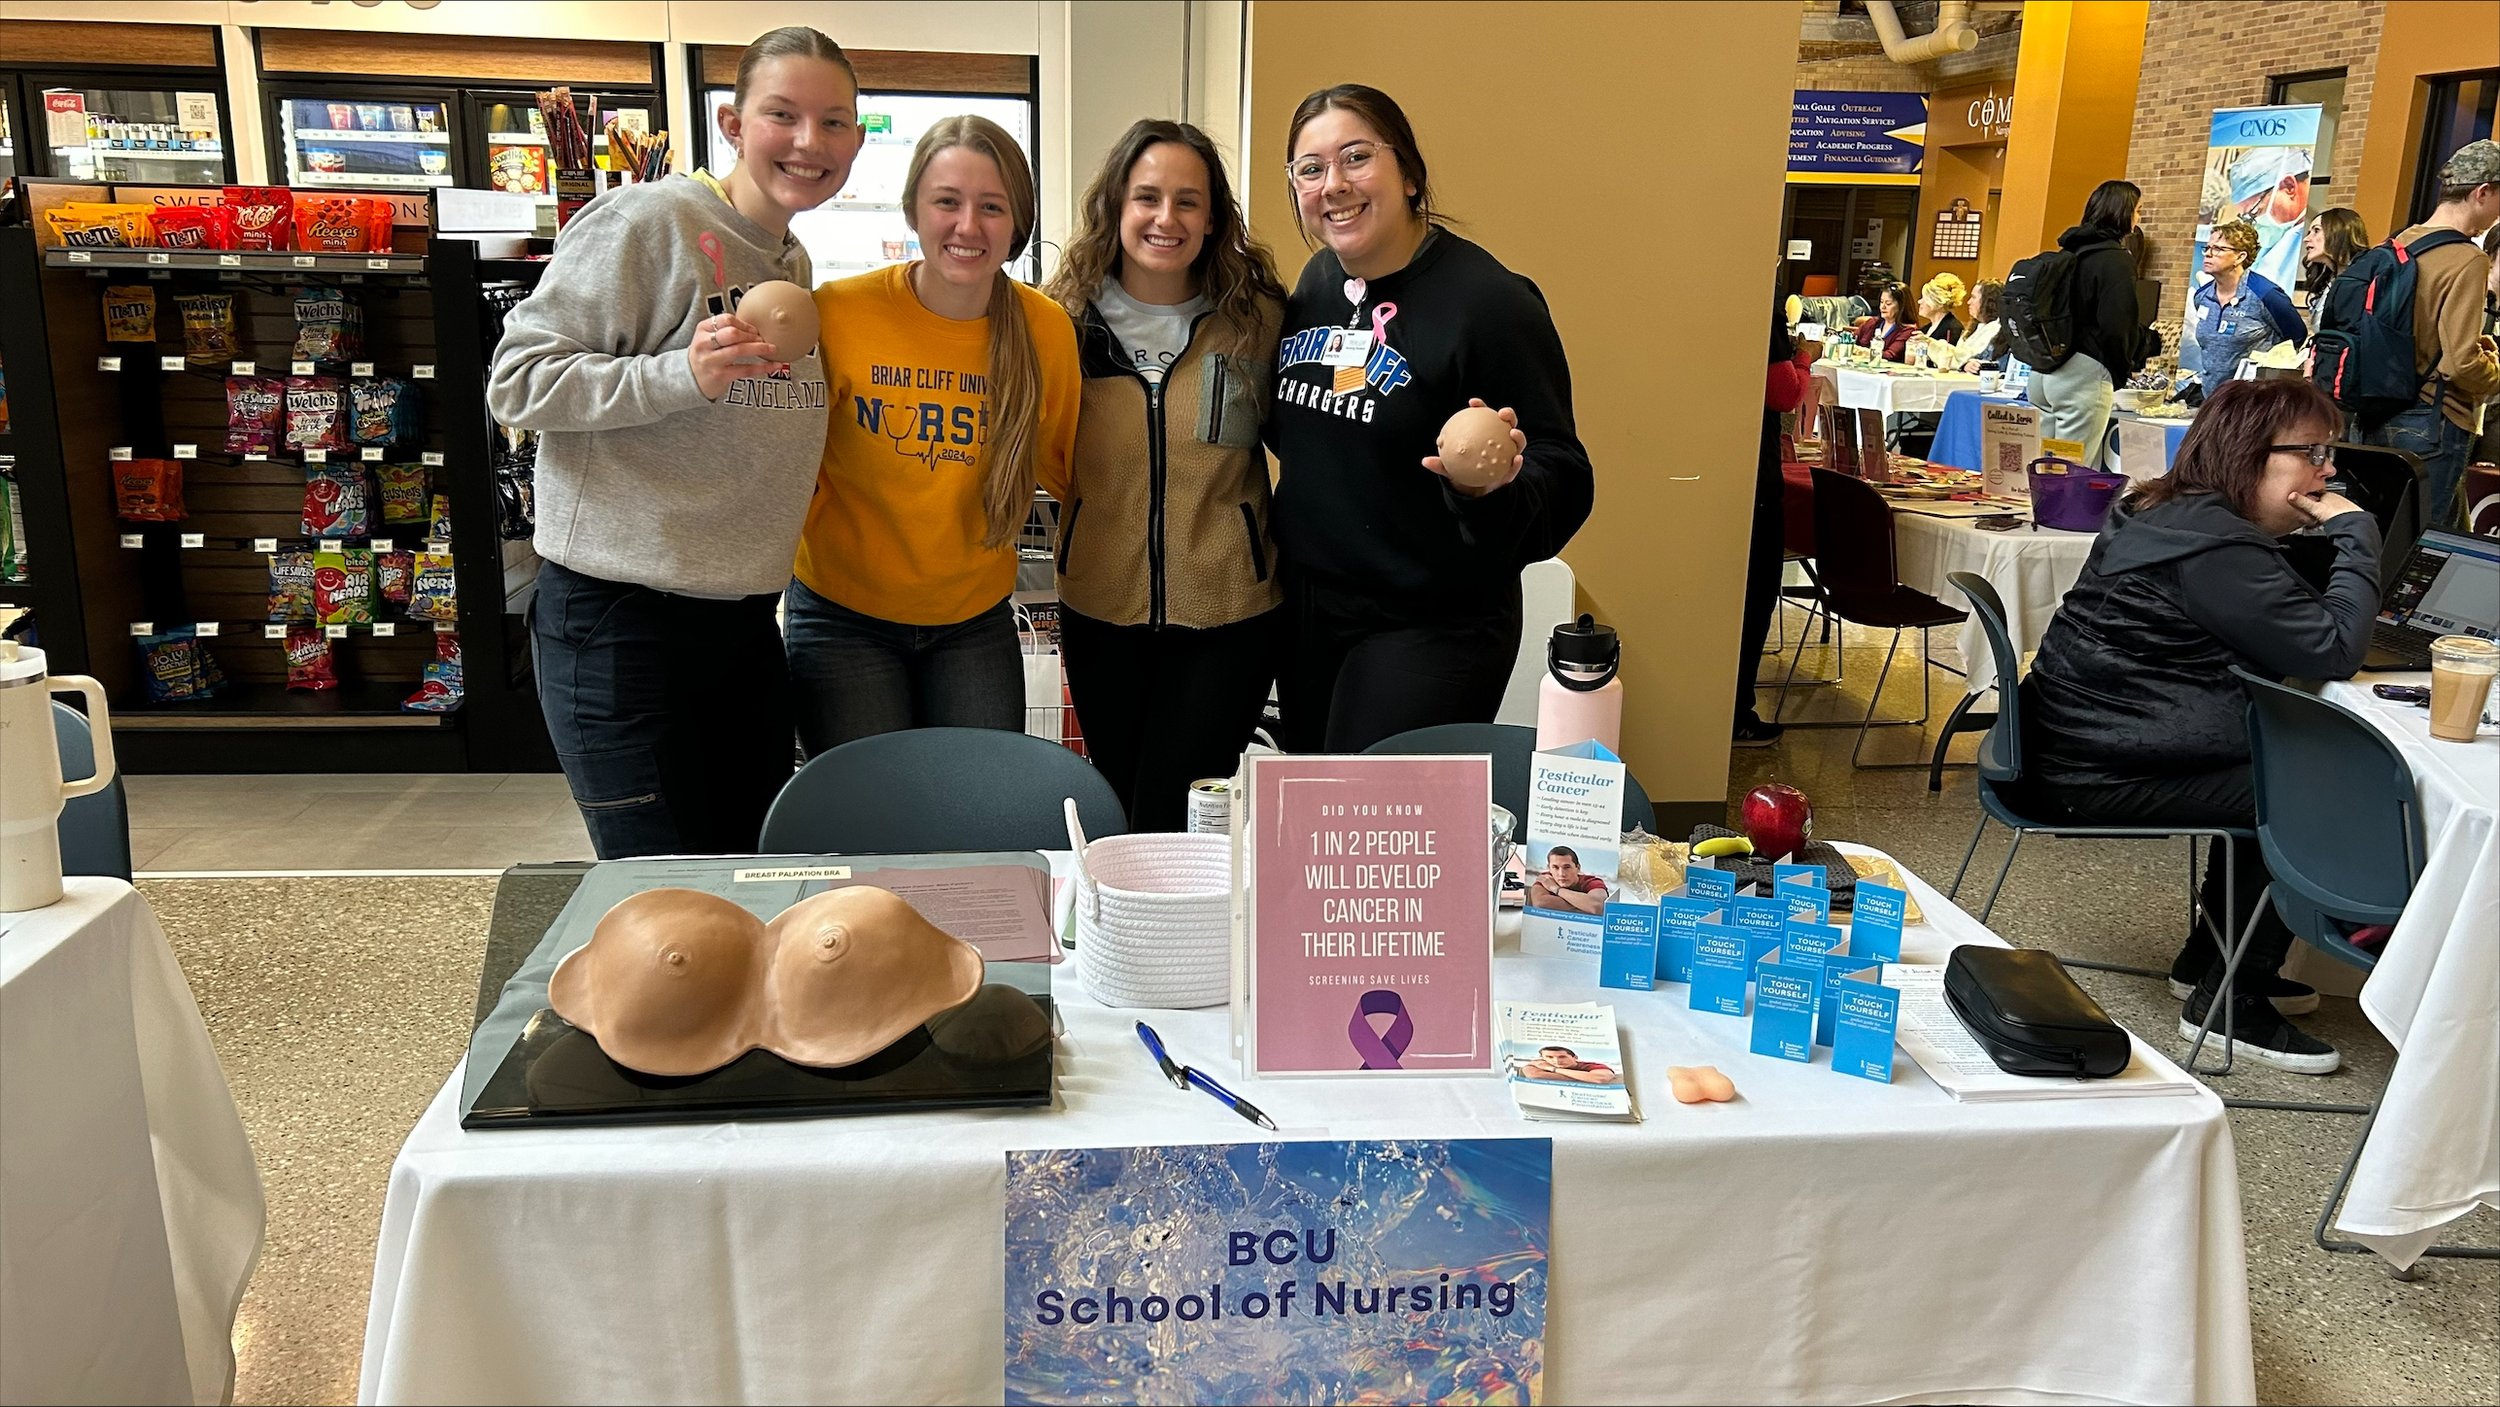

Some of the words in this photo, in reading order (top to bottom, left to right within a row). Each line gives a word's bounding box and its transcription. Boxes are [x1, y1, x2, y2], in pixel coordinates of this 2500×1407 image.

[1815, 115, 1861, 125] NAVIGATION
[1862, 117, 1896, 126] SERVICES
[2240, 118, 2287, 138] CNOS
[1816, 141, 1856, 150] ACADEMIC
[1856, 141, 1893, 151] PROGRESS
[308, 221, 359, 238] Reese's
[322, 238, 348, 246] minis
[297, 303, 342, 319] Welch's
[1279, 326, 1344, 374] BRIA
[871, 365, 911, 387] BRIAR
[917, 368, 954, 391] CLIFF
[724, 379, 827, 410] ENGLAND
[1278, 378, 1375, 423] CHARGERS
[288, 394, 336, 411] Welch's
[941, 449, 966, 460] 2024
[345, 573, 369, 586] AIR
[329, 586, 369, 604] HEADS
[1538, 768, 1614, 787] Testicular
[1537, 780, 1590, 797] Cancer
[1322, 804, 1344, 816] DID
[1352, 804, 1378, 816] YOU
[1386, 804, 1424, 816] KNOW
[1310, 831, 1318, 856] 1
[1324, 831, 1343, 856] IN
[1348, 831, 1360, 855] 2
[1365, 831, 1436, 855] PEOPLE
[778, 870, 822, 878] PALPATION
[1305, 864, 1351, 890] WILL
[1355, 864, 1441, 889] DEVELOP
[1696, 881, 1722, 891] TOUCH
[1690, 887, 1729, 899] YOURSELF
[1790, 898, 1816, 909] TOUCH
[1866, 897, 1892, 909] TOUCH
[1323, 898, 1399, 923] CANCER
[1404, 898, 1423, 923] IN
[1746, 911, 1774, 920] TOUCH
[1859, 903, 1898, 917] YOURSELF
[1616, 918, 1643, 926] TOUCH
[1673, 912, 1700, 921] TOUCH
[1608, 924, 1650, 934] YOURSELF
[1739, 918, 1780, 928] YOURSELF
[1566, 935, 1590, 943] Cancer
[1568, 929, 1598, 938] Testicular
[1301, 932, 1356, 957] THEIR
[1361, 931, 1445, 957] LIFETIME
[1706, 939, 1736, 949] TOUCH
[1797, 937, 1826, 948] TOUCH
[1699, 945, 1742, 957] YOURSELF
[1308, 975, 1365, 985] SCREENING
[1370, 975, 1395, 985] SAVE
[1401, 974, 1430, 984] LIVES
[1770, 980, 1801, 991] TOUCH
[1762, 986, 1808, 1000] YOURSELF
[1852, 997, 1883, 1010] TOUCH
[1520, 1010, 1603, 1020] Testicular
[1843, 1003, 1890, 1019] YOURSELF
[1520, 1016, 1579, 1024] Cancer
[1228, 1228, 1336, 1267] BCU
[1036, 1284, 1221, 1326] School
[1241, 1280, 1299, 1318] of
[1315, 1273, 1517, 1319] Nursing
